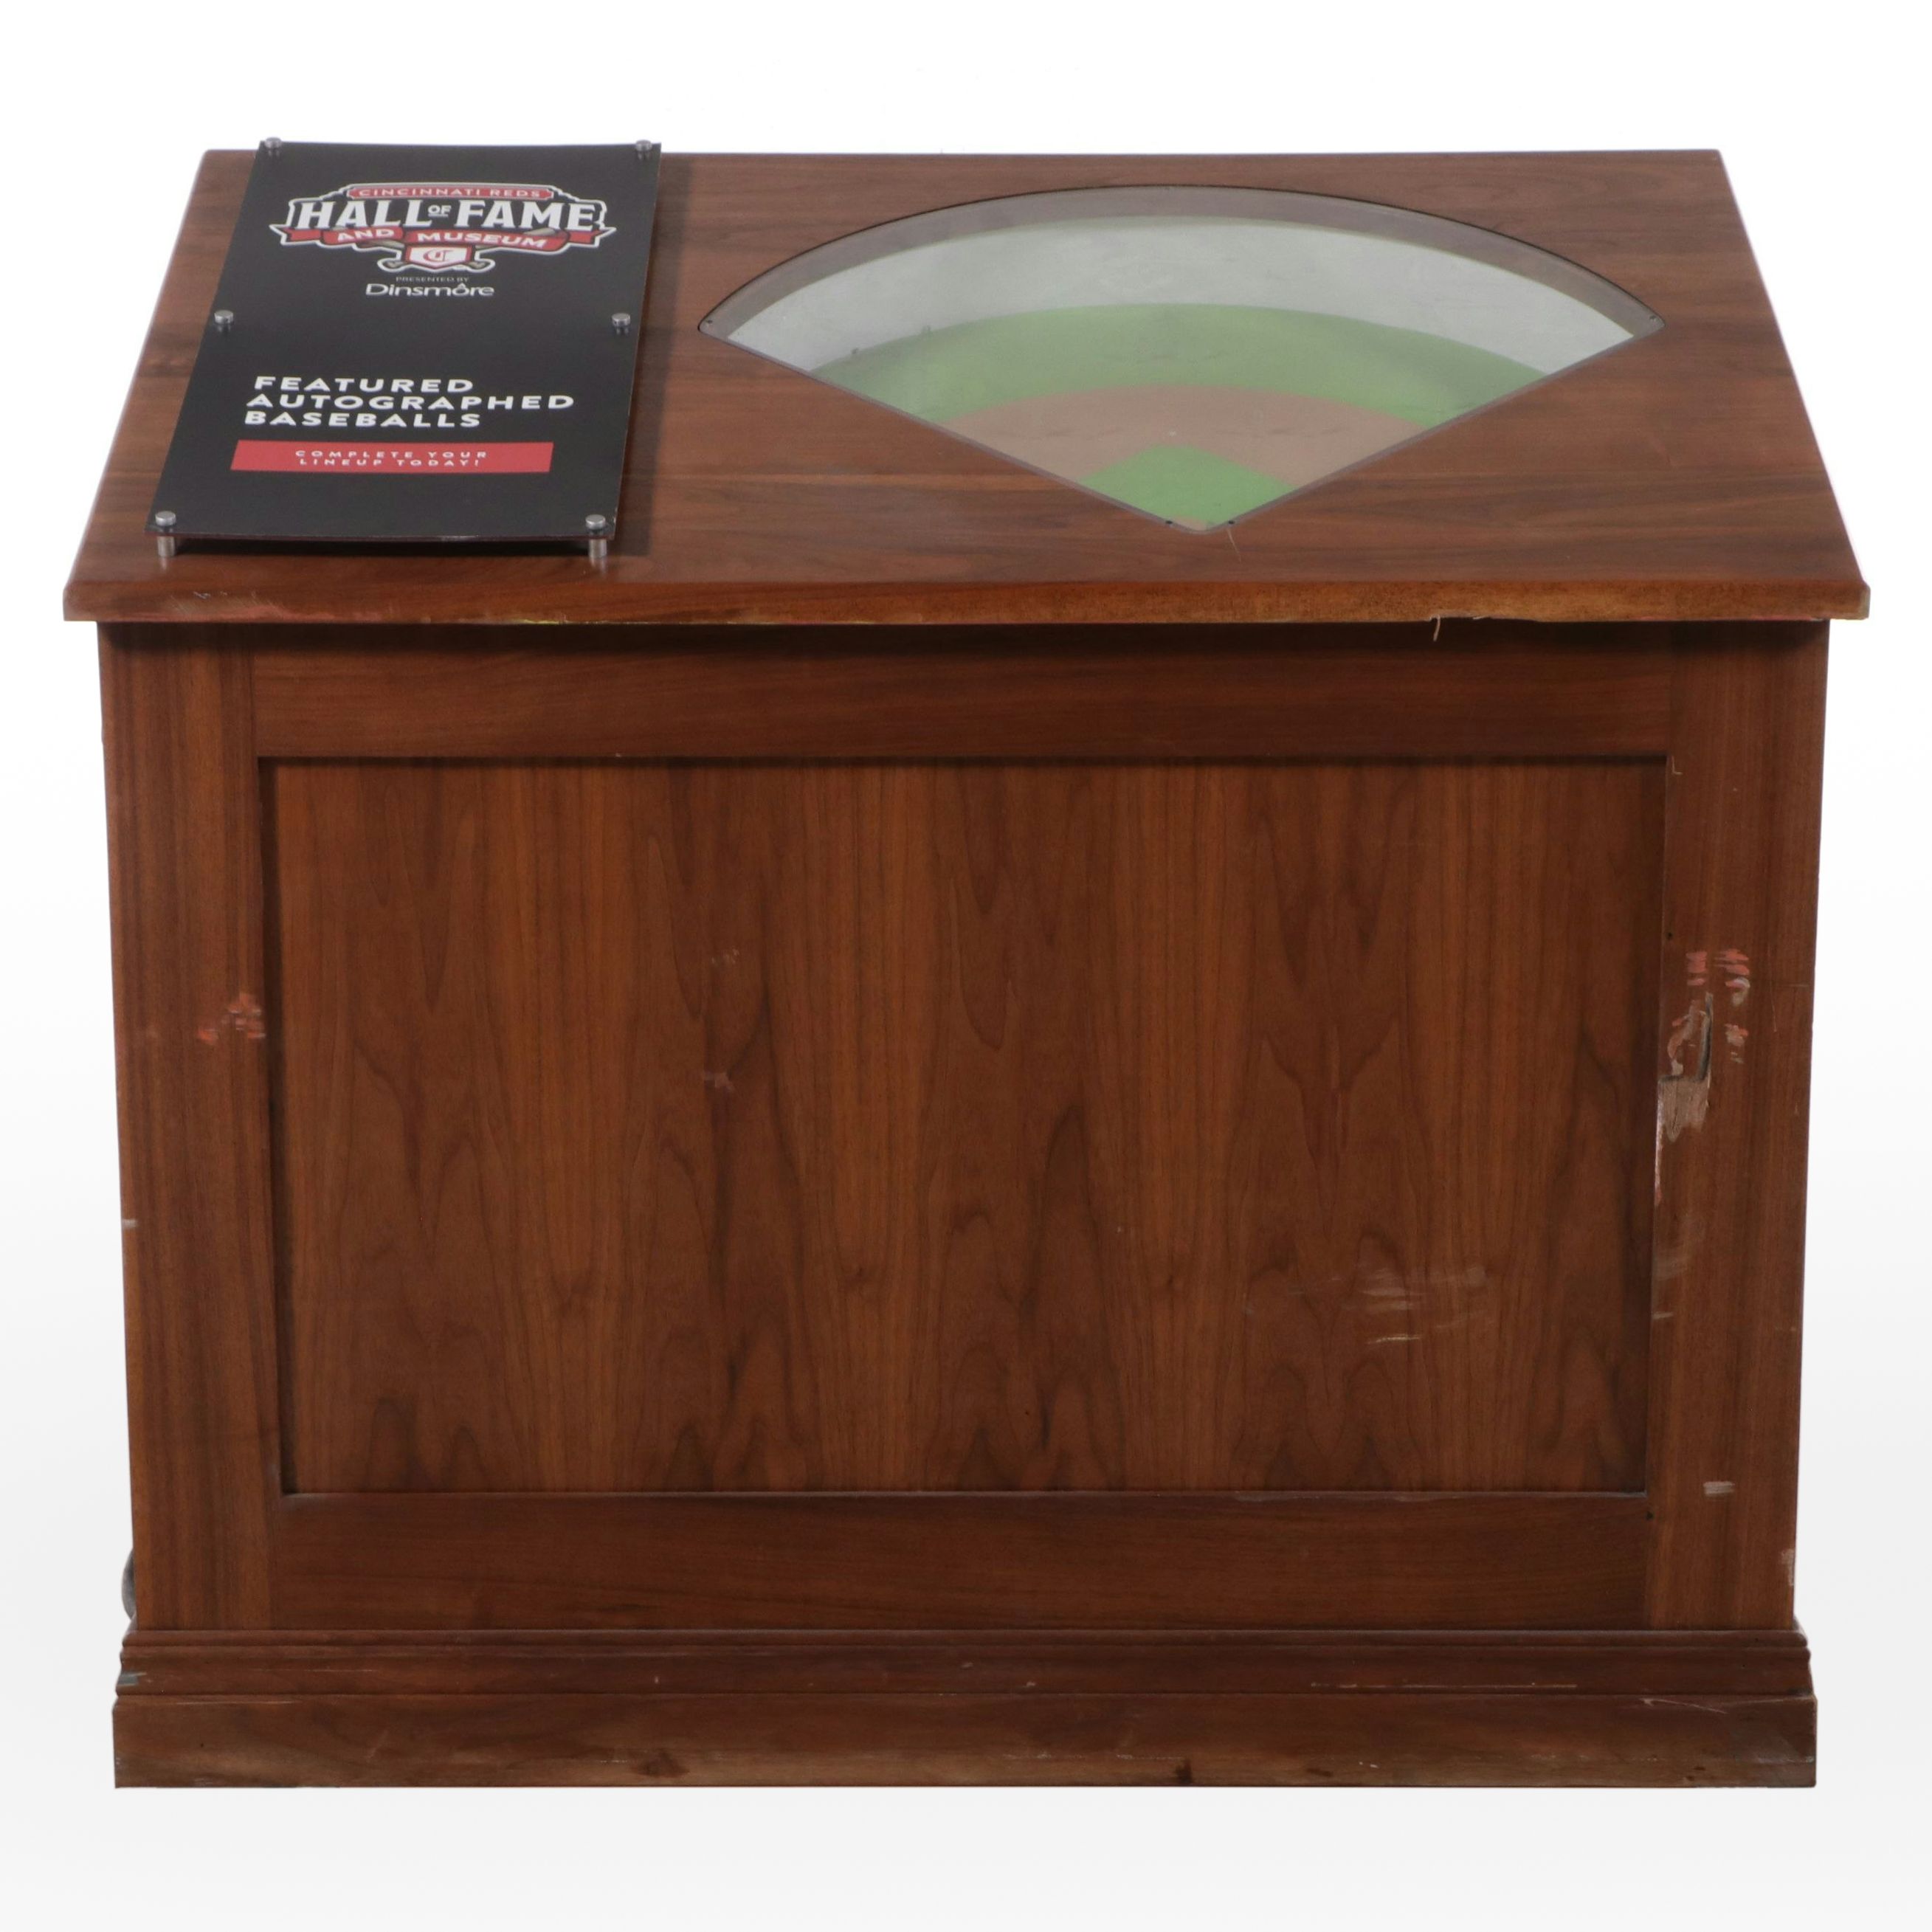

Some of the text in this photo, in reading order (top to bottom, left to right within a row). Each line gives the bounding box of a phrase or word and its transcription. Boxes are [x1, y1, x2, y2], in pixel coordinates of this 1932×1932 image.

[358, 187, 541, 198] CINCINNATI REDS
[296, 199, 596, 231] HALL OF FAME
[337, 227, 548, 249] AND MUSEUM
[253, 376, 474, 393] FEATURED
[246, 393, 574, 410] AUTOGRAPHED
[244, 410, 481, 427] BASEBALLS
[295, 450, 488, 459] COMPLETE YOUR
[299, 458, 481, 467] LINEUP TODAY!
